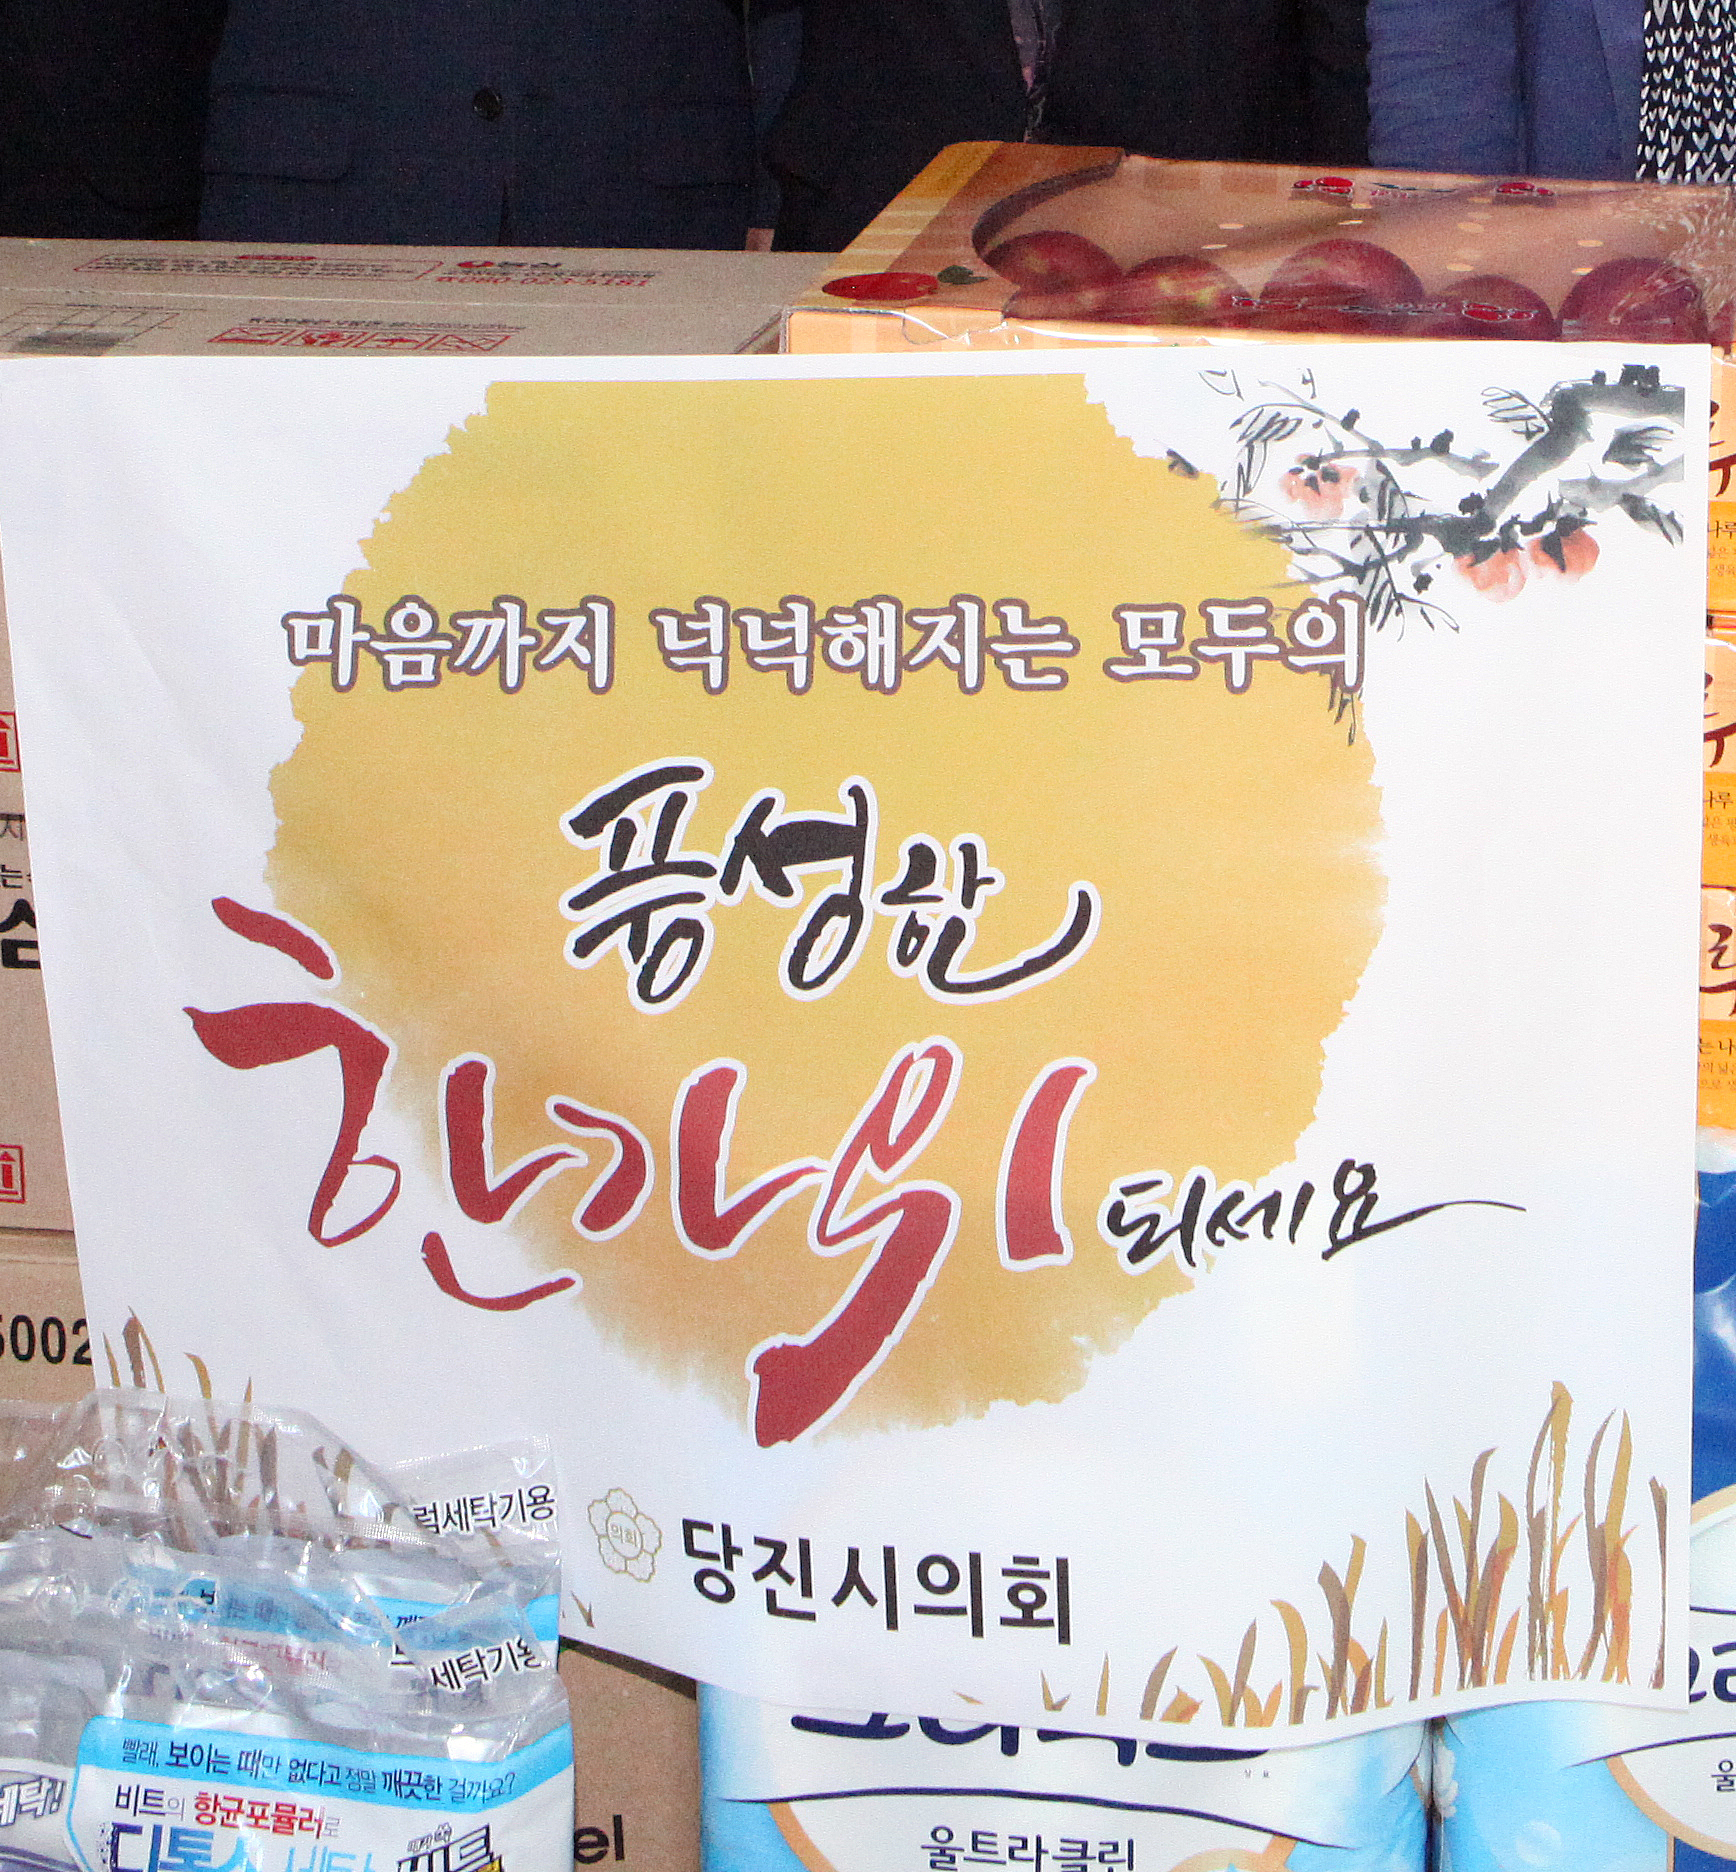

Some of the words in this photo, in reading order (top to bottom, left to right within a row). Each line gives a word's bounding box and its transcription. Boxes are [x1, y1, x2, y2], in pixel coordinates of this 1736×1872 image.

[281, 591, 616, 694] 마음까지
[652, 593, 1086, 697] 넉넉해지는
[1109, 591, 1370, 695] 모두의
[567, 763, 1094, 1004] 풍성한
[183, 894, 1097, 1450] 한가위
[1107, 1162, 1527, 1273] 되세요
[680, 1517, 1073, 1646] 당진시의회
[115, 1784, 187, 1822] 비트의
[194, 1790, 341, 1840] 항균포뮬러로
[165, 1740, 231, 1775] 보이는
[237, 1748, 283, 1780] 때만
[288, 1758, 342, 1787] 없다고
[344, 1766, 379, 1794] 정말
[382, 1768, 444, 1801] 깨끗한
[448, 1770, 517, 1805] 걸까요?
